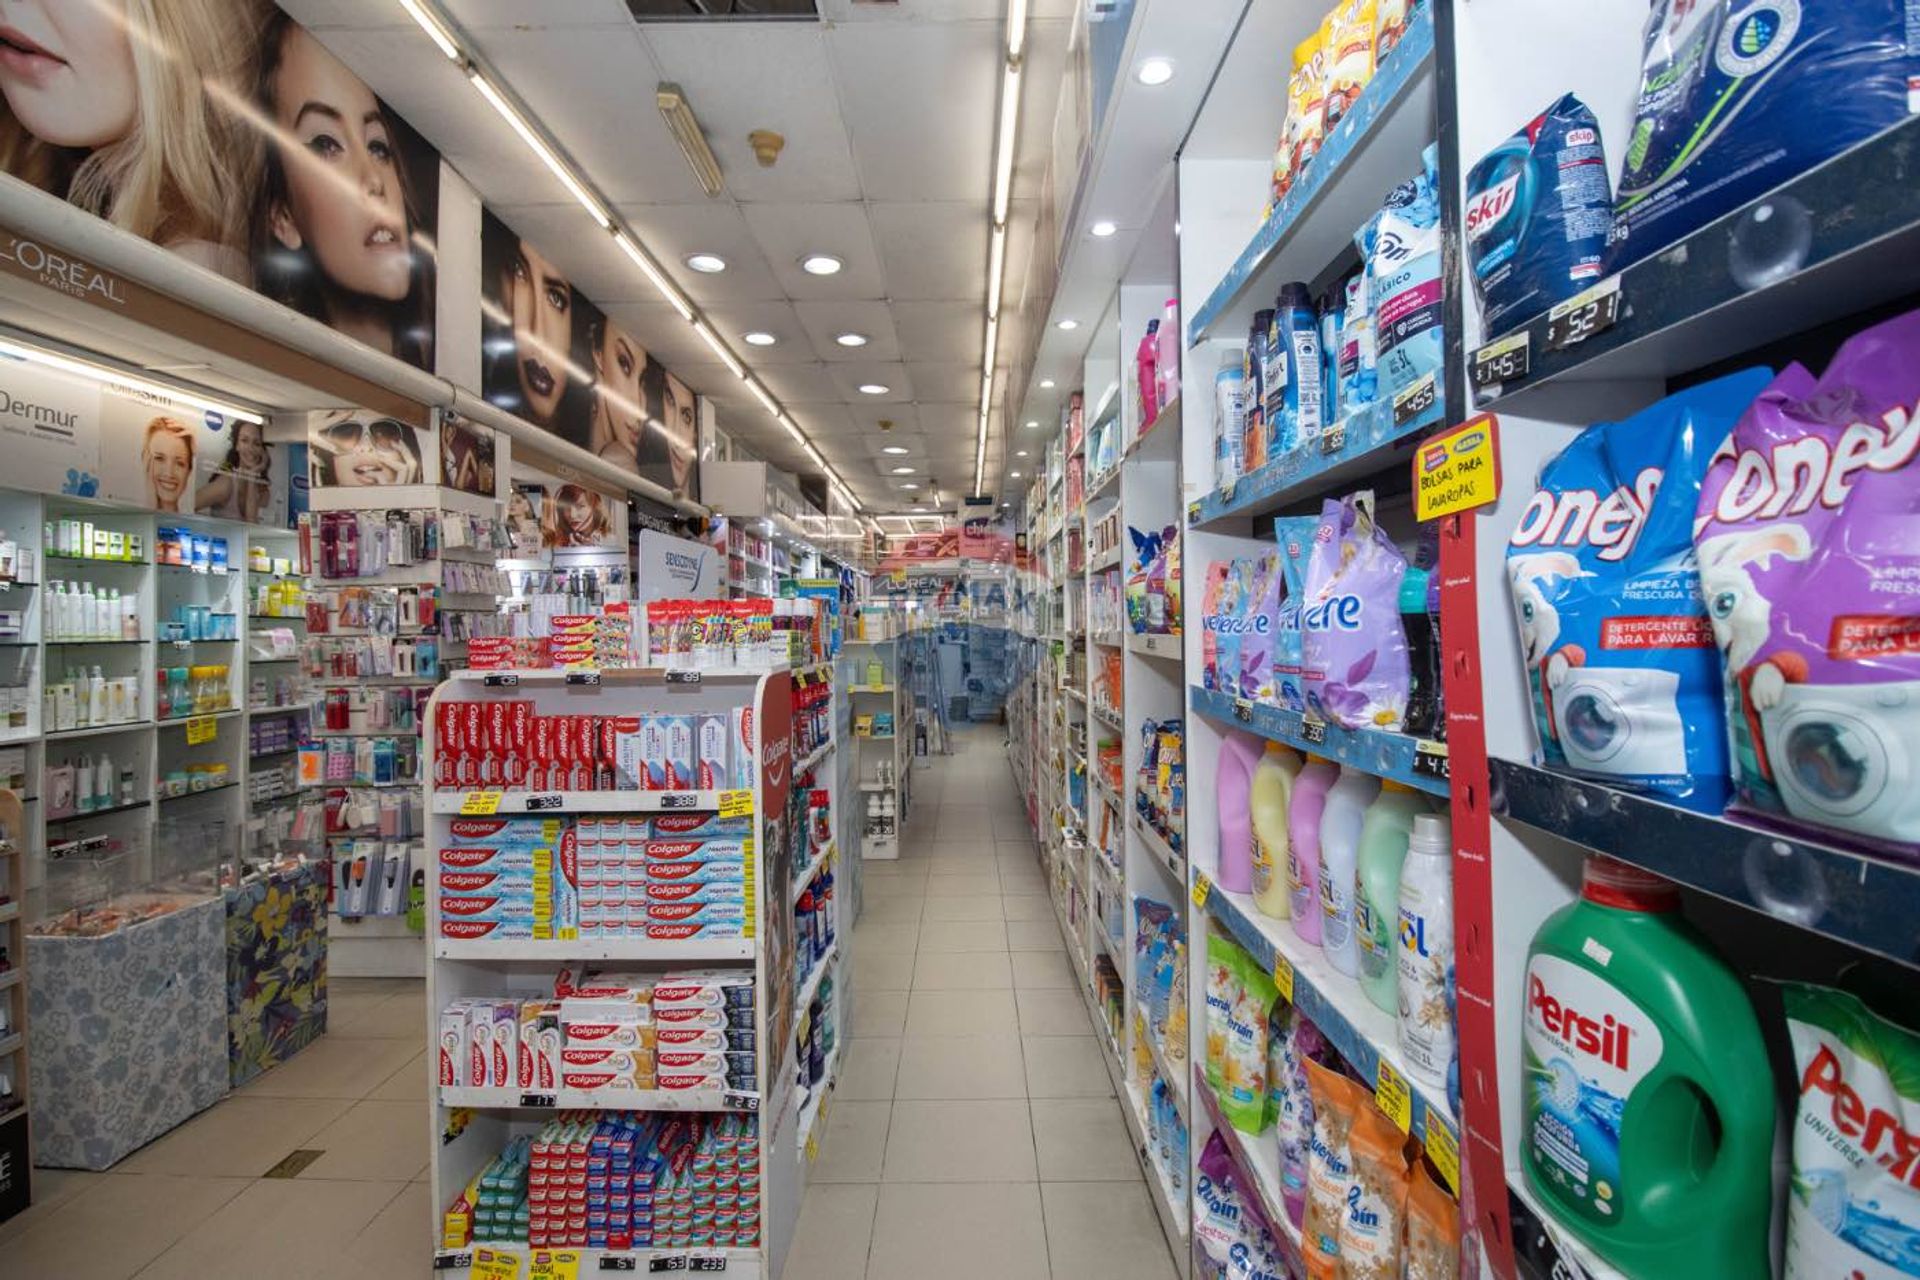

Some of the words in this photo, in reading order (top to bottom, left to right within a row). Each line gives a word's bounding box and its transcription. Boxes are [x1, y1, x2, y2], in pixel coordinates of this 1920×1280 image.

[1568, 133, 1594, 148] skip
[40, 272, 85, 298] PARIS
[1421, 468, 1454, 491] BOLSAS
[1457, 456, 1483, 473] PARA
[1624, 579, 1681, 591] LIMPIEZA
[1622, 591, 1684, 601] FRESCURA
[553, 616, 588, 626] Colgate
[1608, 621, 1687, 634] DETERGENTE
[469, 638, 501, 647] Colgate
[553, 634, 588, 644] Colgate
[1608, 635, 1644, 647] PARA
[1649, 633, 1697, 646] LAVAR
[470, 655, 502, 664] Colgate
[554, 653, 588, 662] Colgate
[447, 704, 458, 748] Colgate
[470, 704, 480, 748] Colgate
[493, 704, 504, 746] Colgate
[516, 704, 527, 747] Colgate
[540, 720, 549, 759] Colgate
[560, 720, 570, 759] Colgate
[583, 720, 593, 759] Colgate
[606, 720, 616, 759] Colgate
[763, 737, 790, 767] Colgate
[540, 796, 563, 807] 322
[657, 817, 701, 828] Colgate
[453, 824, 497, 835] Colgate
[566, 833, 576, 878] Colgate
[647, 844, 692, 856] Colgate
[442, 852, 486, 863] Colgate
[648, 865, 693, 877] Colgate
[442, 876, 486, 887] Colgate
[648, 885, 693, 897] Colgate
[442, 900, 487, 911] Colgate
[650, 905, 694, 917] Colgate
[443, 924, 487, 935] Colgate
[648, 926, 692, 938] Colgate
[656, 988, 696, 999] Colgate
[658, 1009, 698, 1020] Colgate
[1528, 971, 1630, 1072] Persil
[569, 1027, 613, 1039] Colgate
[659, 1031, 699, 1042] Colgate
[564, 1052, 608, 1065] Colgate
[659, 1055, 699, 1066] Colgate
[473, 1049, 483, 1086] Colgate
[495, 1049, 503, 1086] Colgate
[518, 1048, 529, 1087] Colgate
[566, 1076, 612, 1087] Colgate
[659, 1077, 699, 1087] Colgate
